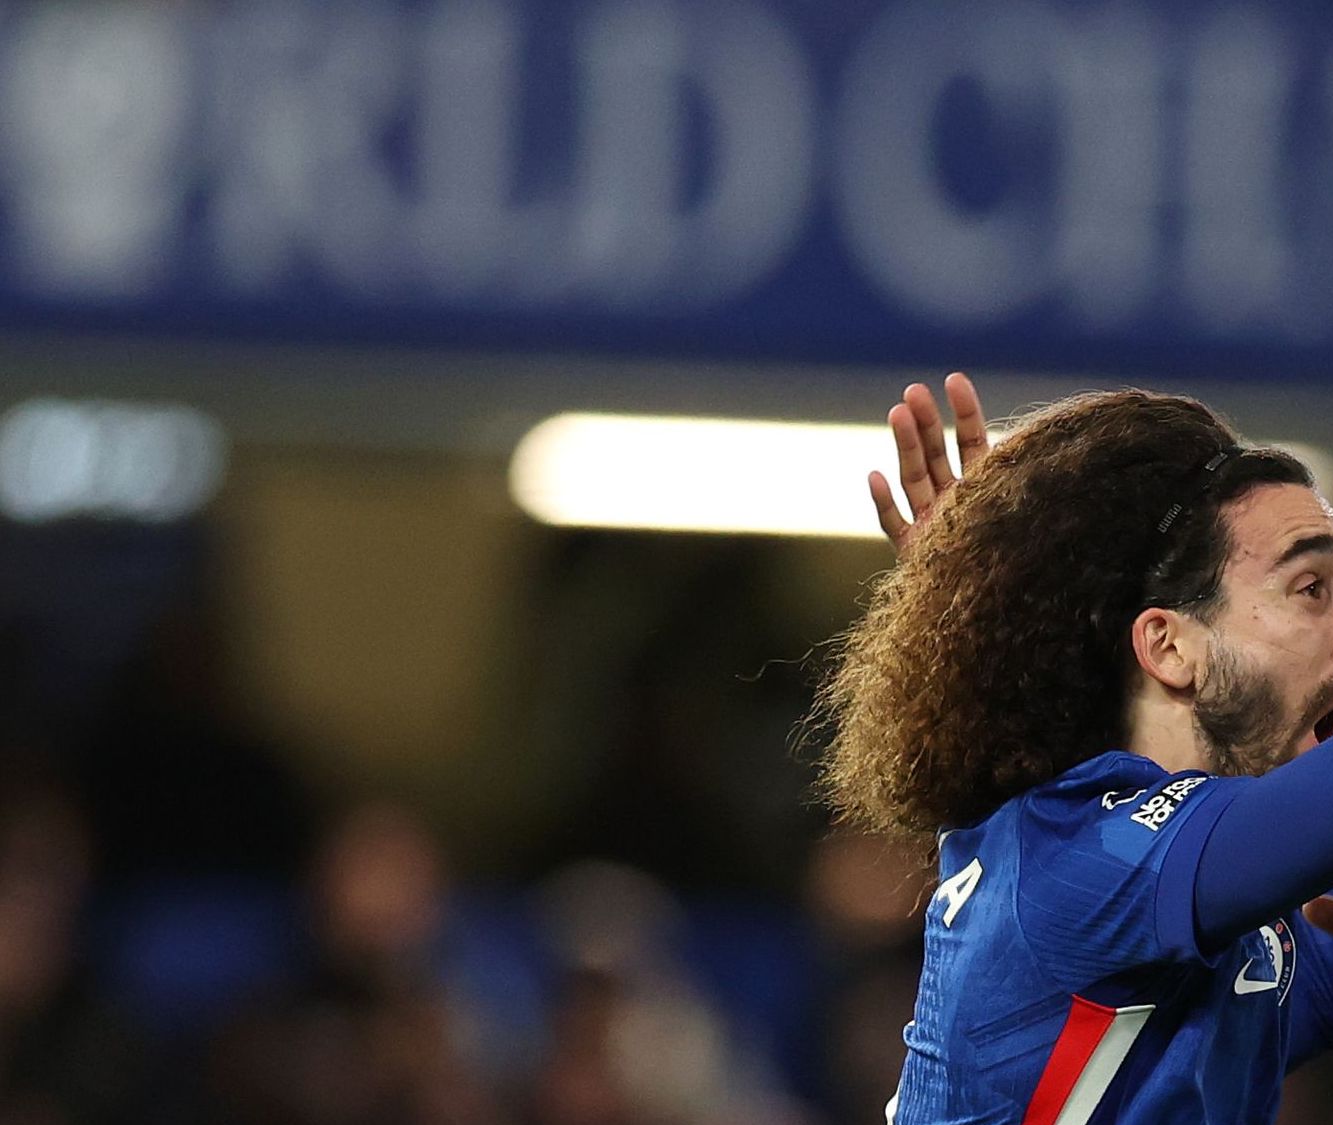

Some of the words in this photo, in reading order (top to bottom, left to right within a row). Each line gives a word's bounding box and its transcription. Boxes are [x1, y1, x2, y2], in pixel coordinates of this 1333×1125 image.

[5, 0, 812, 315] RLD
[1130, 795, 1166, 824] No
[1162, 777, 1207, 796] roo
[1144, 800, 1175, 832] For
